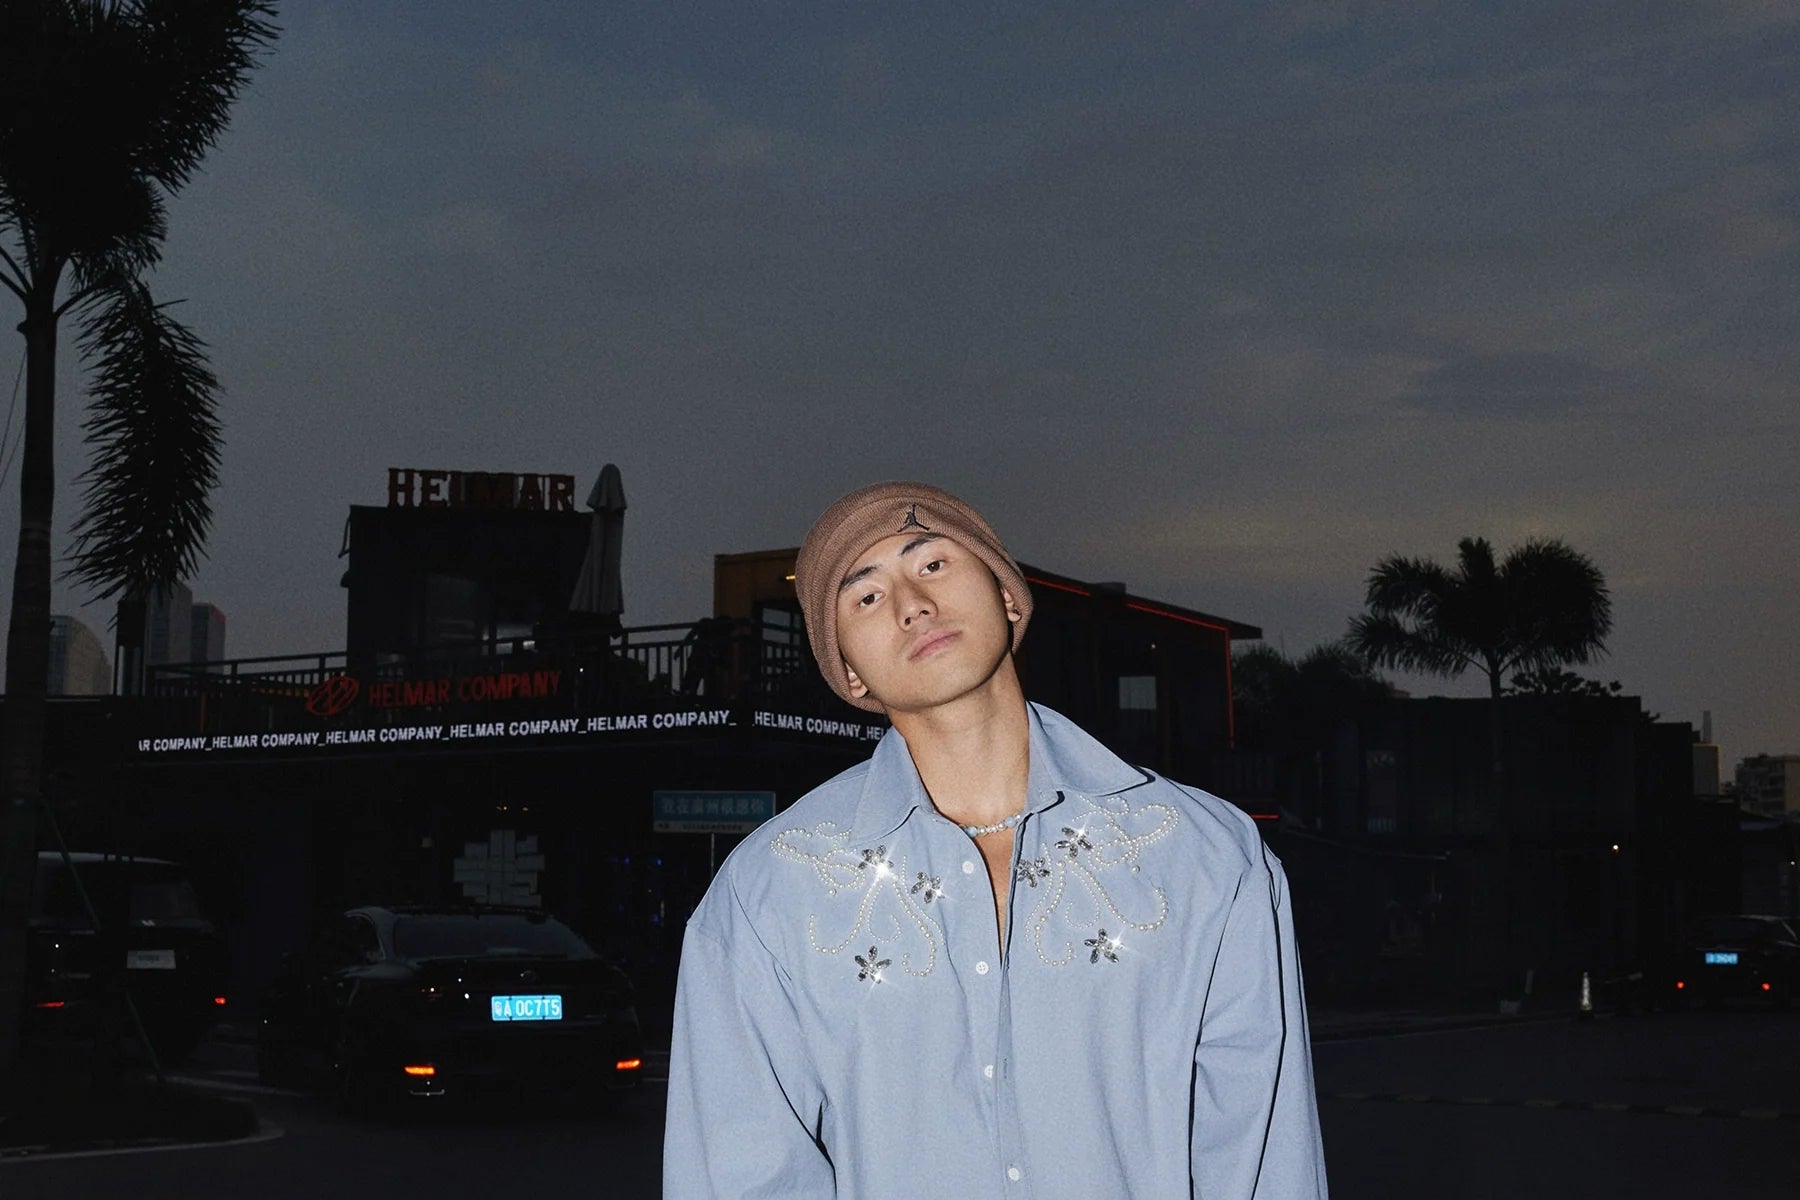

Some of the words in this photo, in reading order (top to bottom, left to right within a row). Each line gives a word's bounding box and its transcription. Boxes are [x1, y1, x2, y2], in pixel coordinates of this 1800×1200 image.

[388, 468, 576, 512] HELMAR
[368, 679, 451, 709] HELMAR
[457, 671, 562, 702] COMPANY
